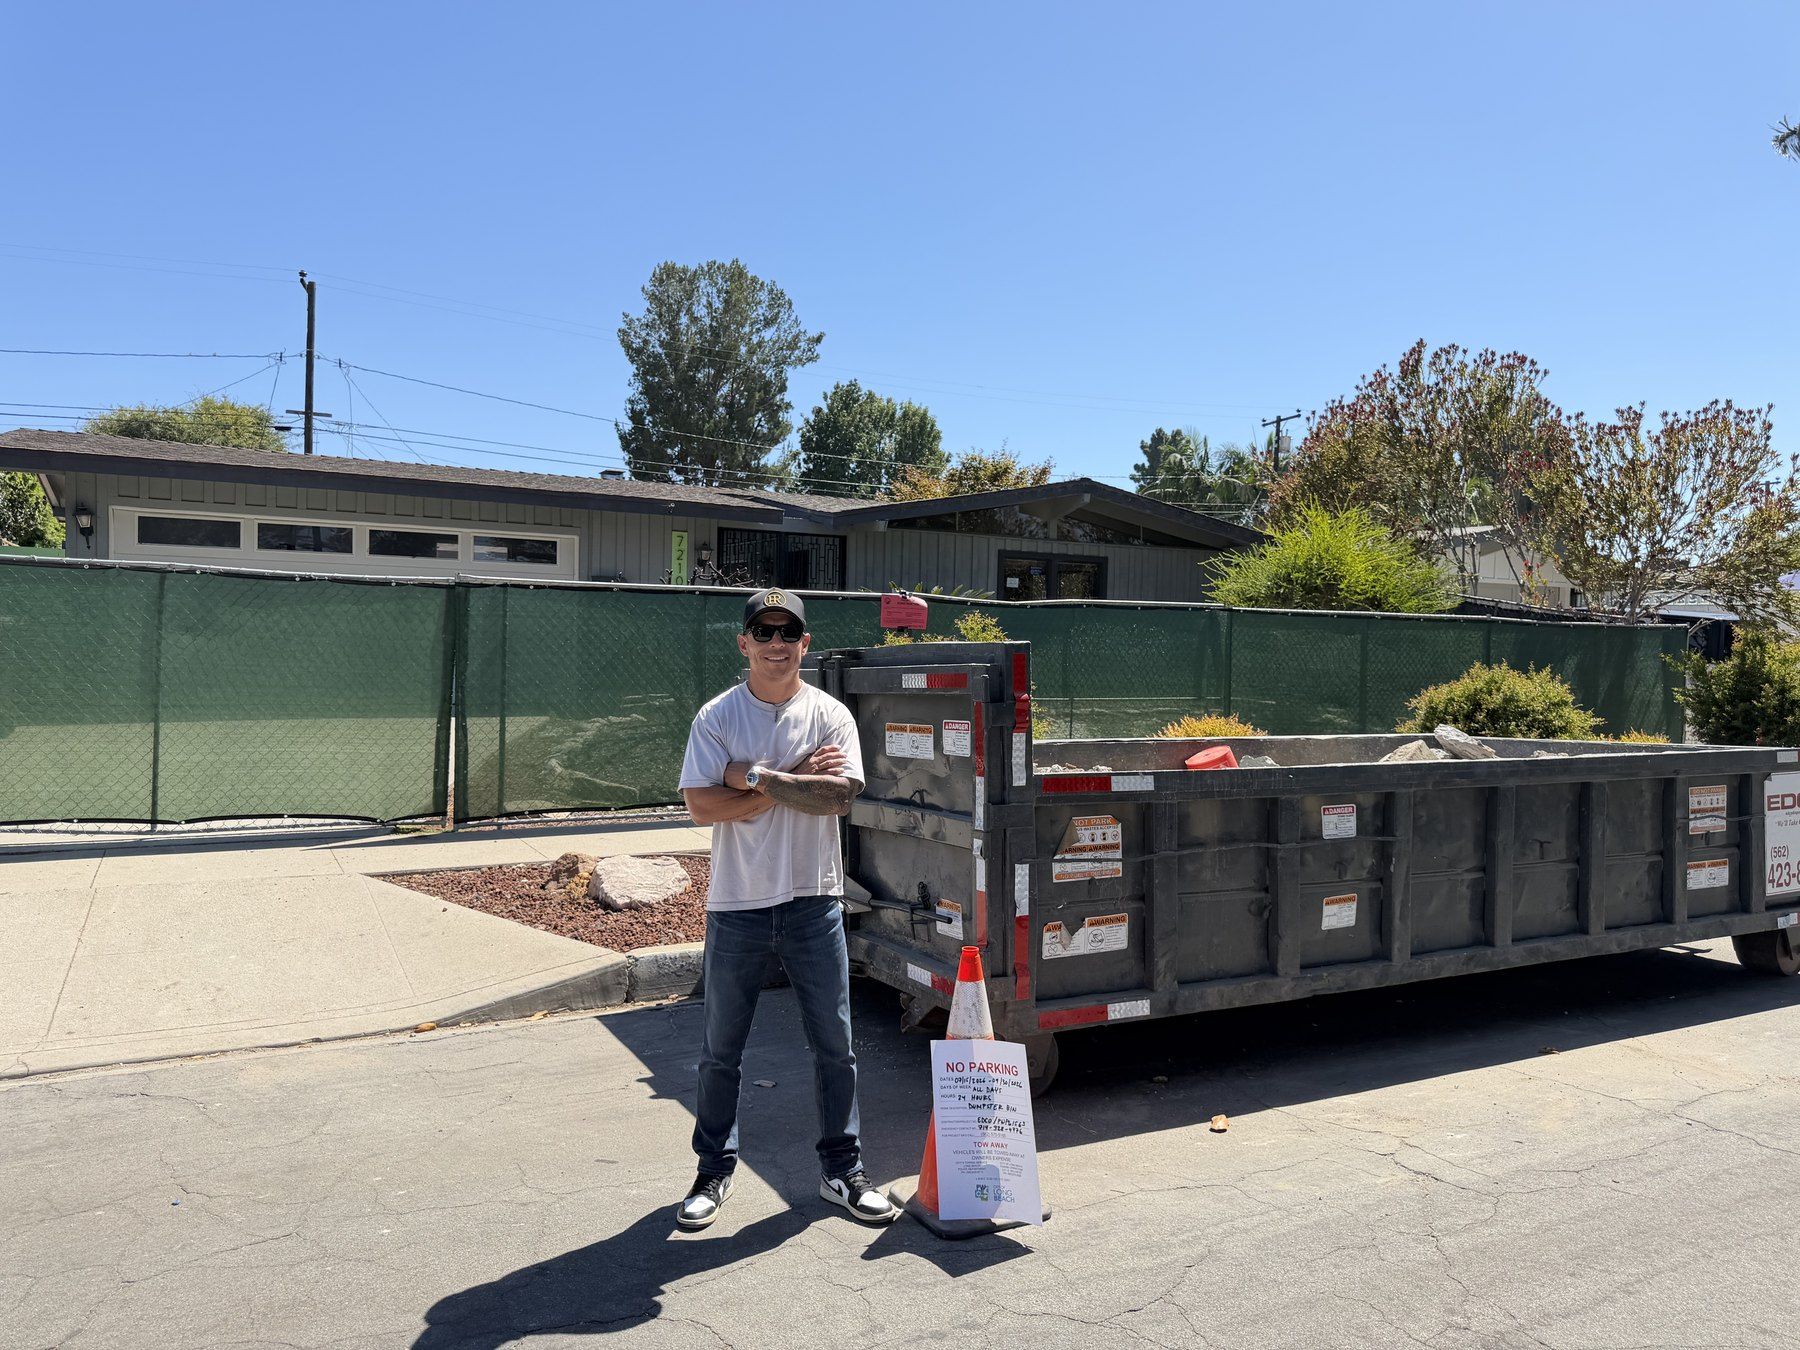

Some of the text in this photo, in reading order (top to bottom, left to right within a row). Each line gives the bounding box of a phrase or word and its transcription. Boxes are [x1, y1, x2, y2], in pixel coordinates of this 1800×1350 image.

[676, 535, 684, 585] 7210
[1093, 843, 1120, 852] WARNING
[1770, 844, 1789, 862] (562)
[1329, 896, 1356, 904] WARNING
[1094, 915, 1126, 926] WARNING
[946, 1062, 1019, 1076] NO PARKING
[986, 1086, 1002, 1094] DAYS
[968, 1103, 1003, 1111] DUMPSTER
[990, 1141, 1008, 1149] AWAY
[993, 1188, 1013, 1196] LONG
[993, 1195, 1015, 1203] BEACH
